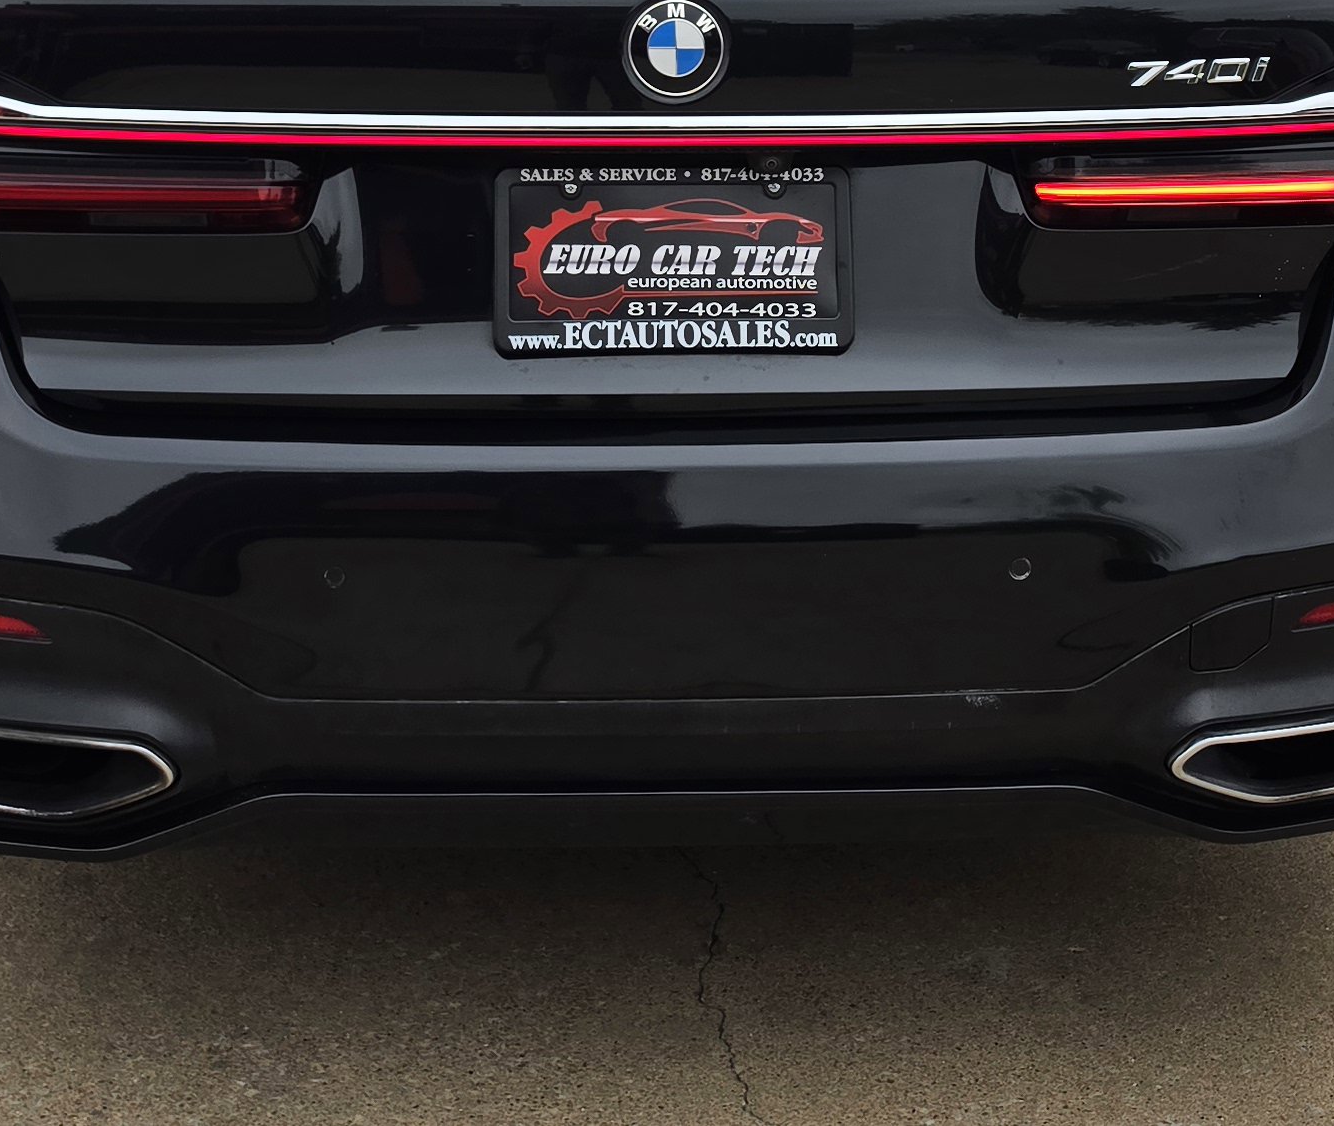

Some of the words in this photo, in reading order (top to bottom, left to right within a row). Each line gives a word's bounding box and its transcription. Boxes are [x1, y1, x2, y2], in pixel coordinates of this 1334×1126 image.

[637, 3, 716, 34] BMW
[1127, 56, 1271, 87] 740i
[520, 168, 574, 182] SALES
[579, 168, 594, 182] &
[598, 167, 677, 182] SERVICE
[543, 244, 641, 275] EURO
[651, 244, 722, 276] CAR
[731, 245, 823, 276] TECH
[627, 277, 712, 291] european
[716, 276, 818, 290] automotive
[627, 301, 817, 318] 817-404-4033
[508, 320, 838, 350] www.ECTAUTOSALES.com
